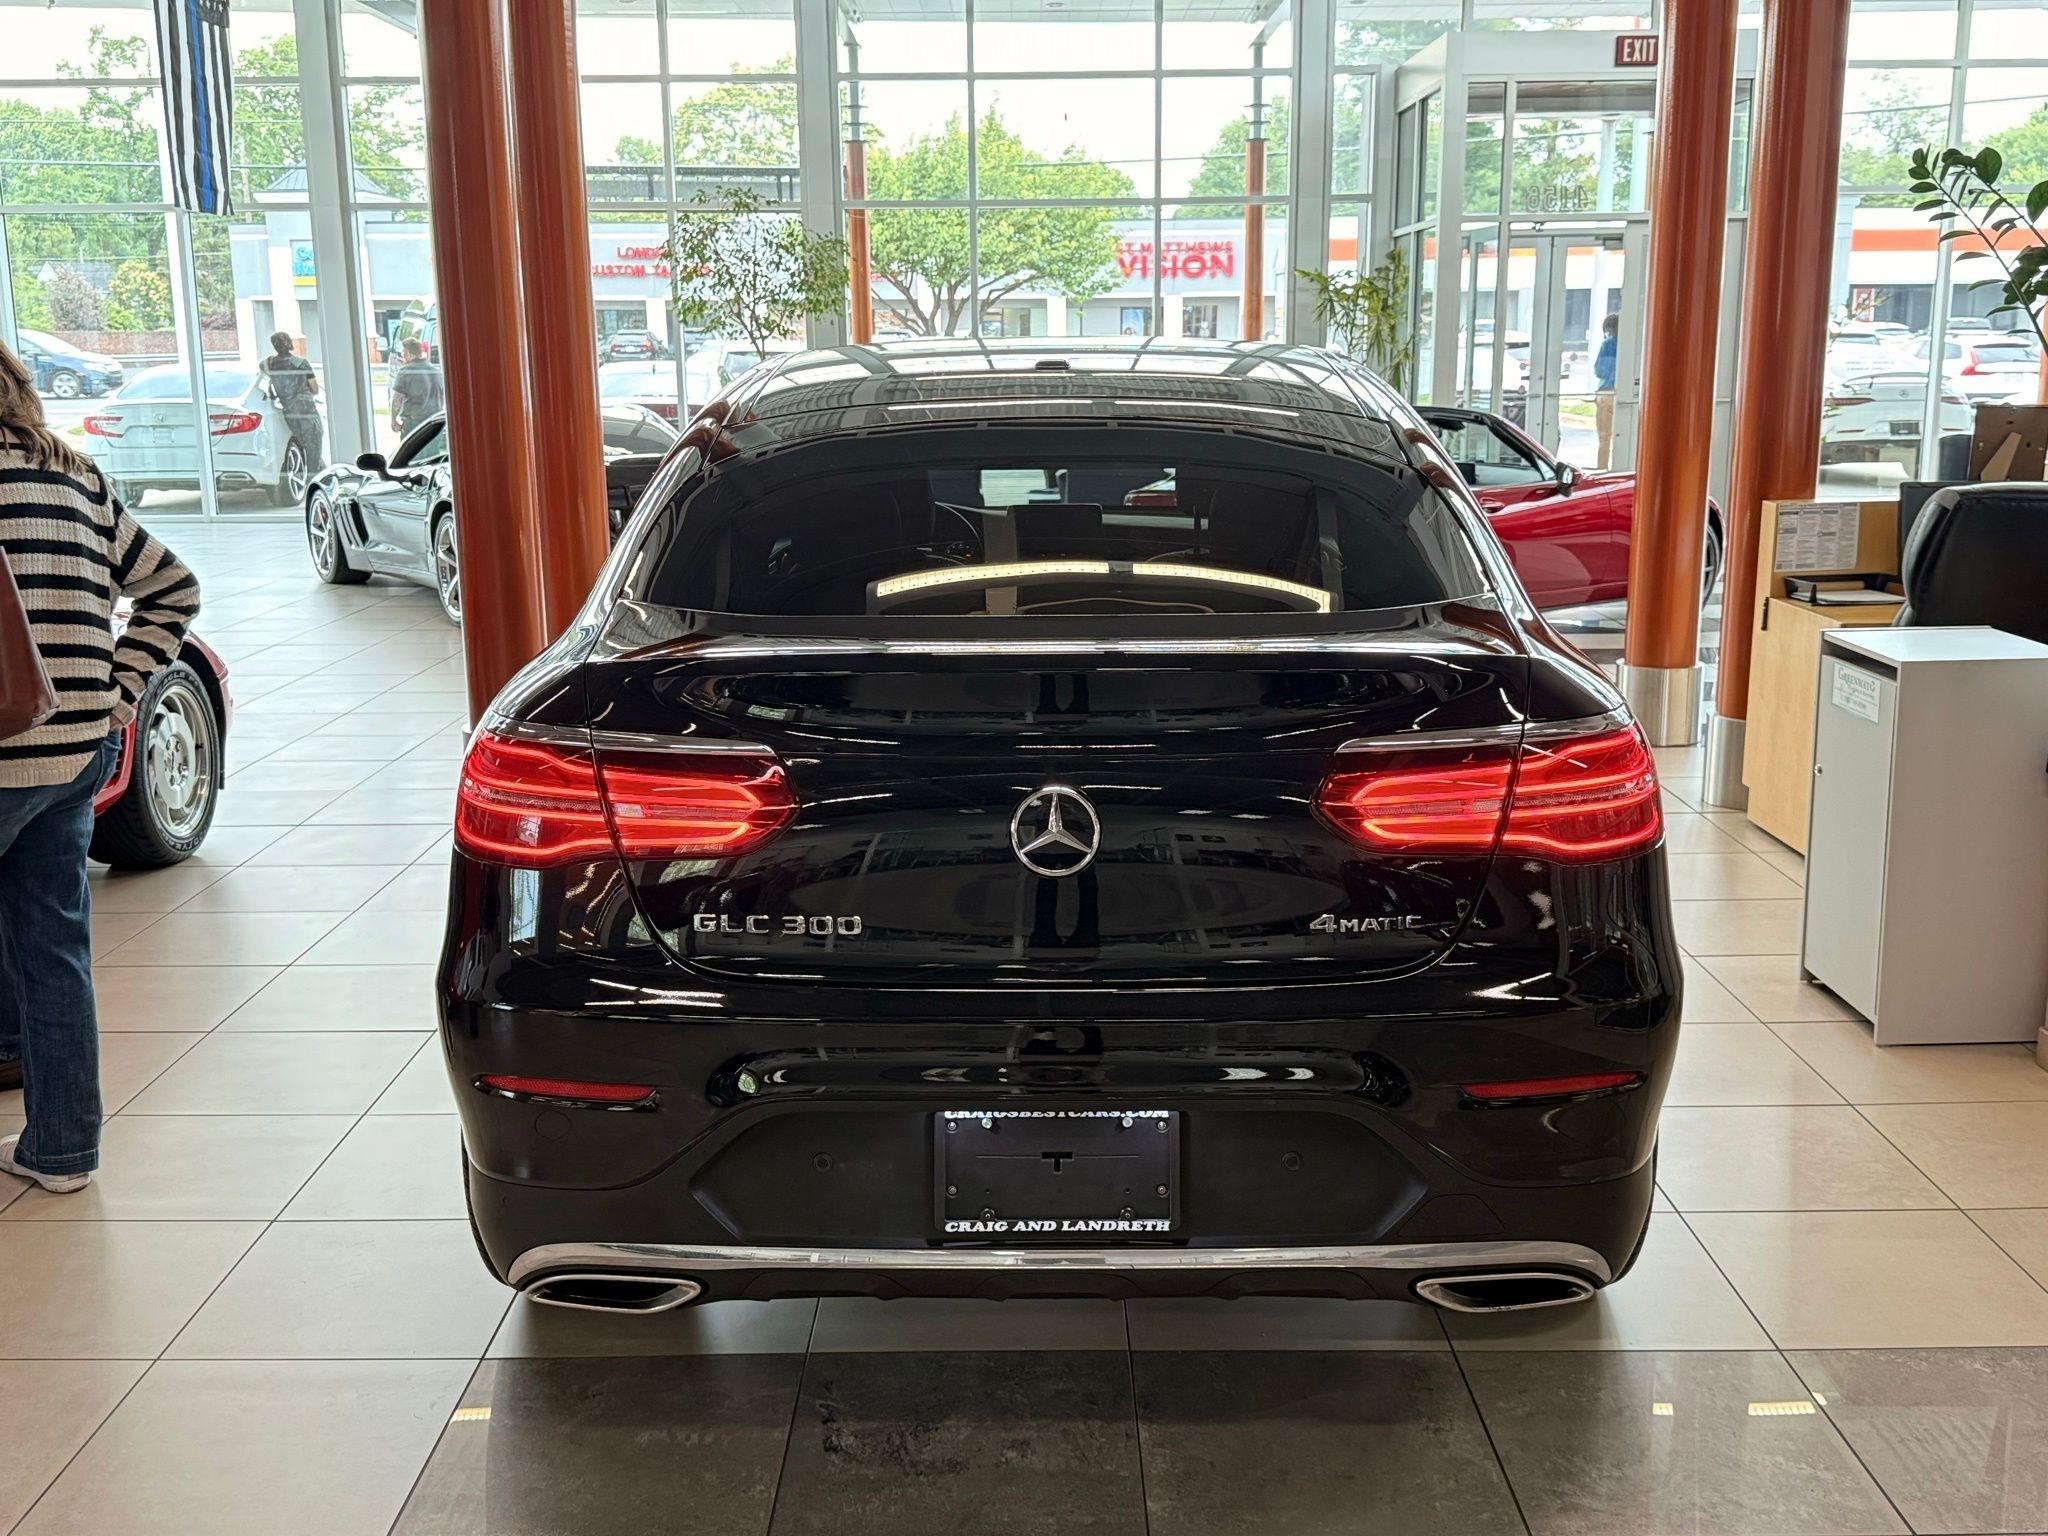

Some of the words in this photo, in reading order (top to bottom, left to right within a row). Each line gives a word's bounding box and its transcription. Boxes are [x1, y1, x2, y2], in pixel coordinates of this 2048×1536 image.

[1623, 38, 1656, 62] EXIT
[617, 246, 664, 259] LONDO
[1139, 241, 1233, 254] MTTHEWS
[693, 913, 770, 933] GLC
[781, 915, 862, 935] 300
[1309, 914, 1421, 932] 4MATIC
[945, 1220, 1008, 1232] CRAIG
[1012, 1220, 1057, 1232] AND
[1061, 1220, 1170, 1232] LANDRETH
